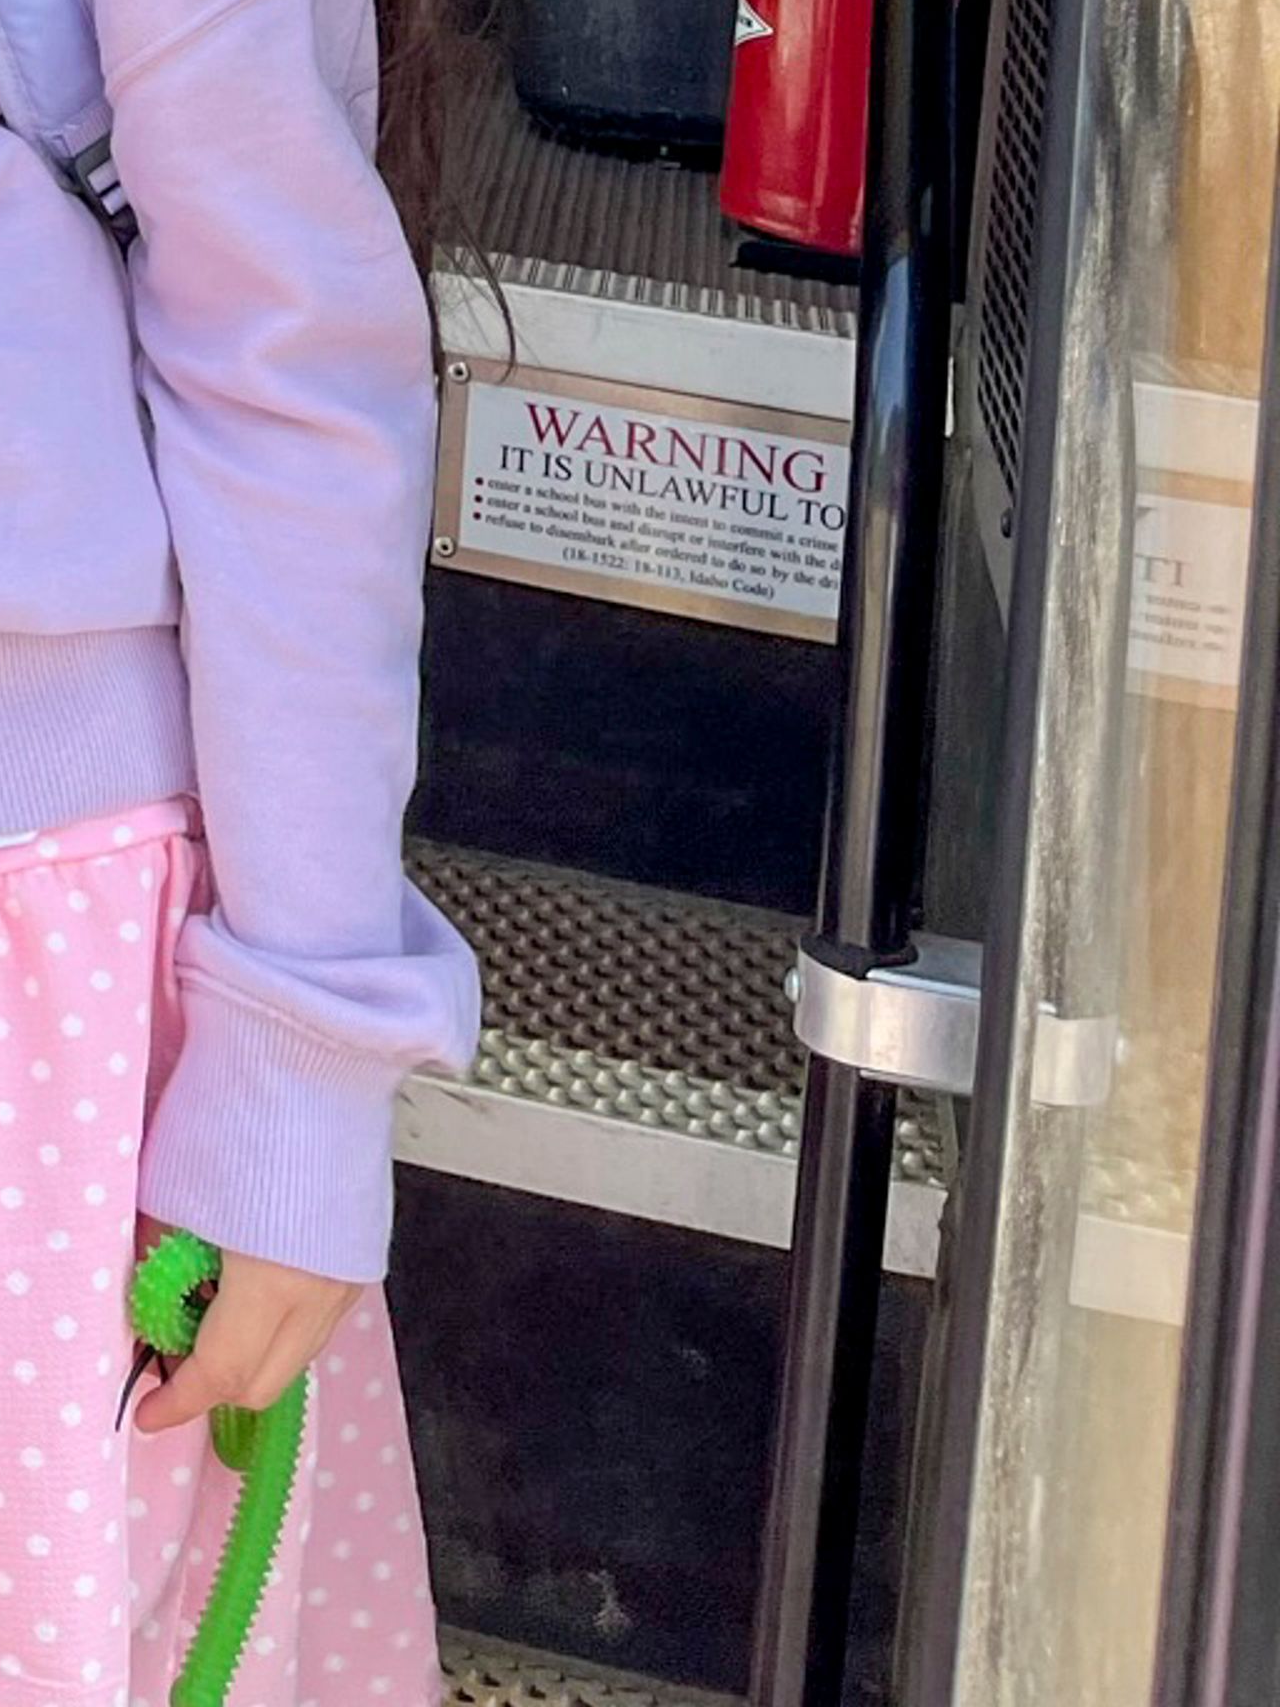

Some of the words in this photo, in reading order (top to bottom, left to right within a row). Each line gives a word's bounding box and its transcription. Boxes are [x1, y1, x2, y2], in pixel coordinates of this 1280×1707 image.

[525, 401, 827, 495] WARNING
[487, 479, 521, 494] enter
[524, 485, 533, 496] a
[535, 485, 580, 506] school
[582, 493, 608, 510] bus
[610, 500, 642, 516] with
[644, 504, 666, 520] the
[670, 511, 709, 530] intent
[712, 518, 728, 531] to
[730, 523, 784, 544] commit
[798, 536, 839, 553] crime
[499, 444, 533, 473] IT
[542, 451, 573, 482] IS
[584, 459, 789, 521] UNLAWFUL
[797, 499, 846, 531] TO
[485, 513, 526, 531] refuse
[529, 521, 543, 535] to
[545, 524, 616, 549] disembark
[619, 536, 651, 554] after
[654, 545, 707, 565] ordered
[710, 554, 725, 569] to
[728, 558, 746, 573] do
[749, 563, 767, 577] so
[771, 564, 790, 583] by
[793, 570, 816, 586] the
[486, 496, 521, 511] enter
[522, 503, 531, 514] a
[534, 503, 579, 524] school
[581, 511, 606, 528] bus
[609, 518, 634, 534] and
[637, 523, 686, 544] disrupt
[689, 533, 704, 546] or
[707, 536, 767, 558] interfere
[769, 549, 801, 566] with
[804, 554, 827, 571] the
[689, 571, 729, 590] Idaho
[731, 578, 775, 600] Code)
